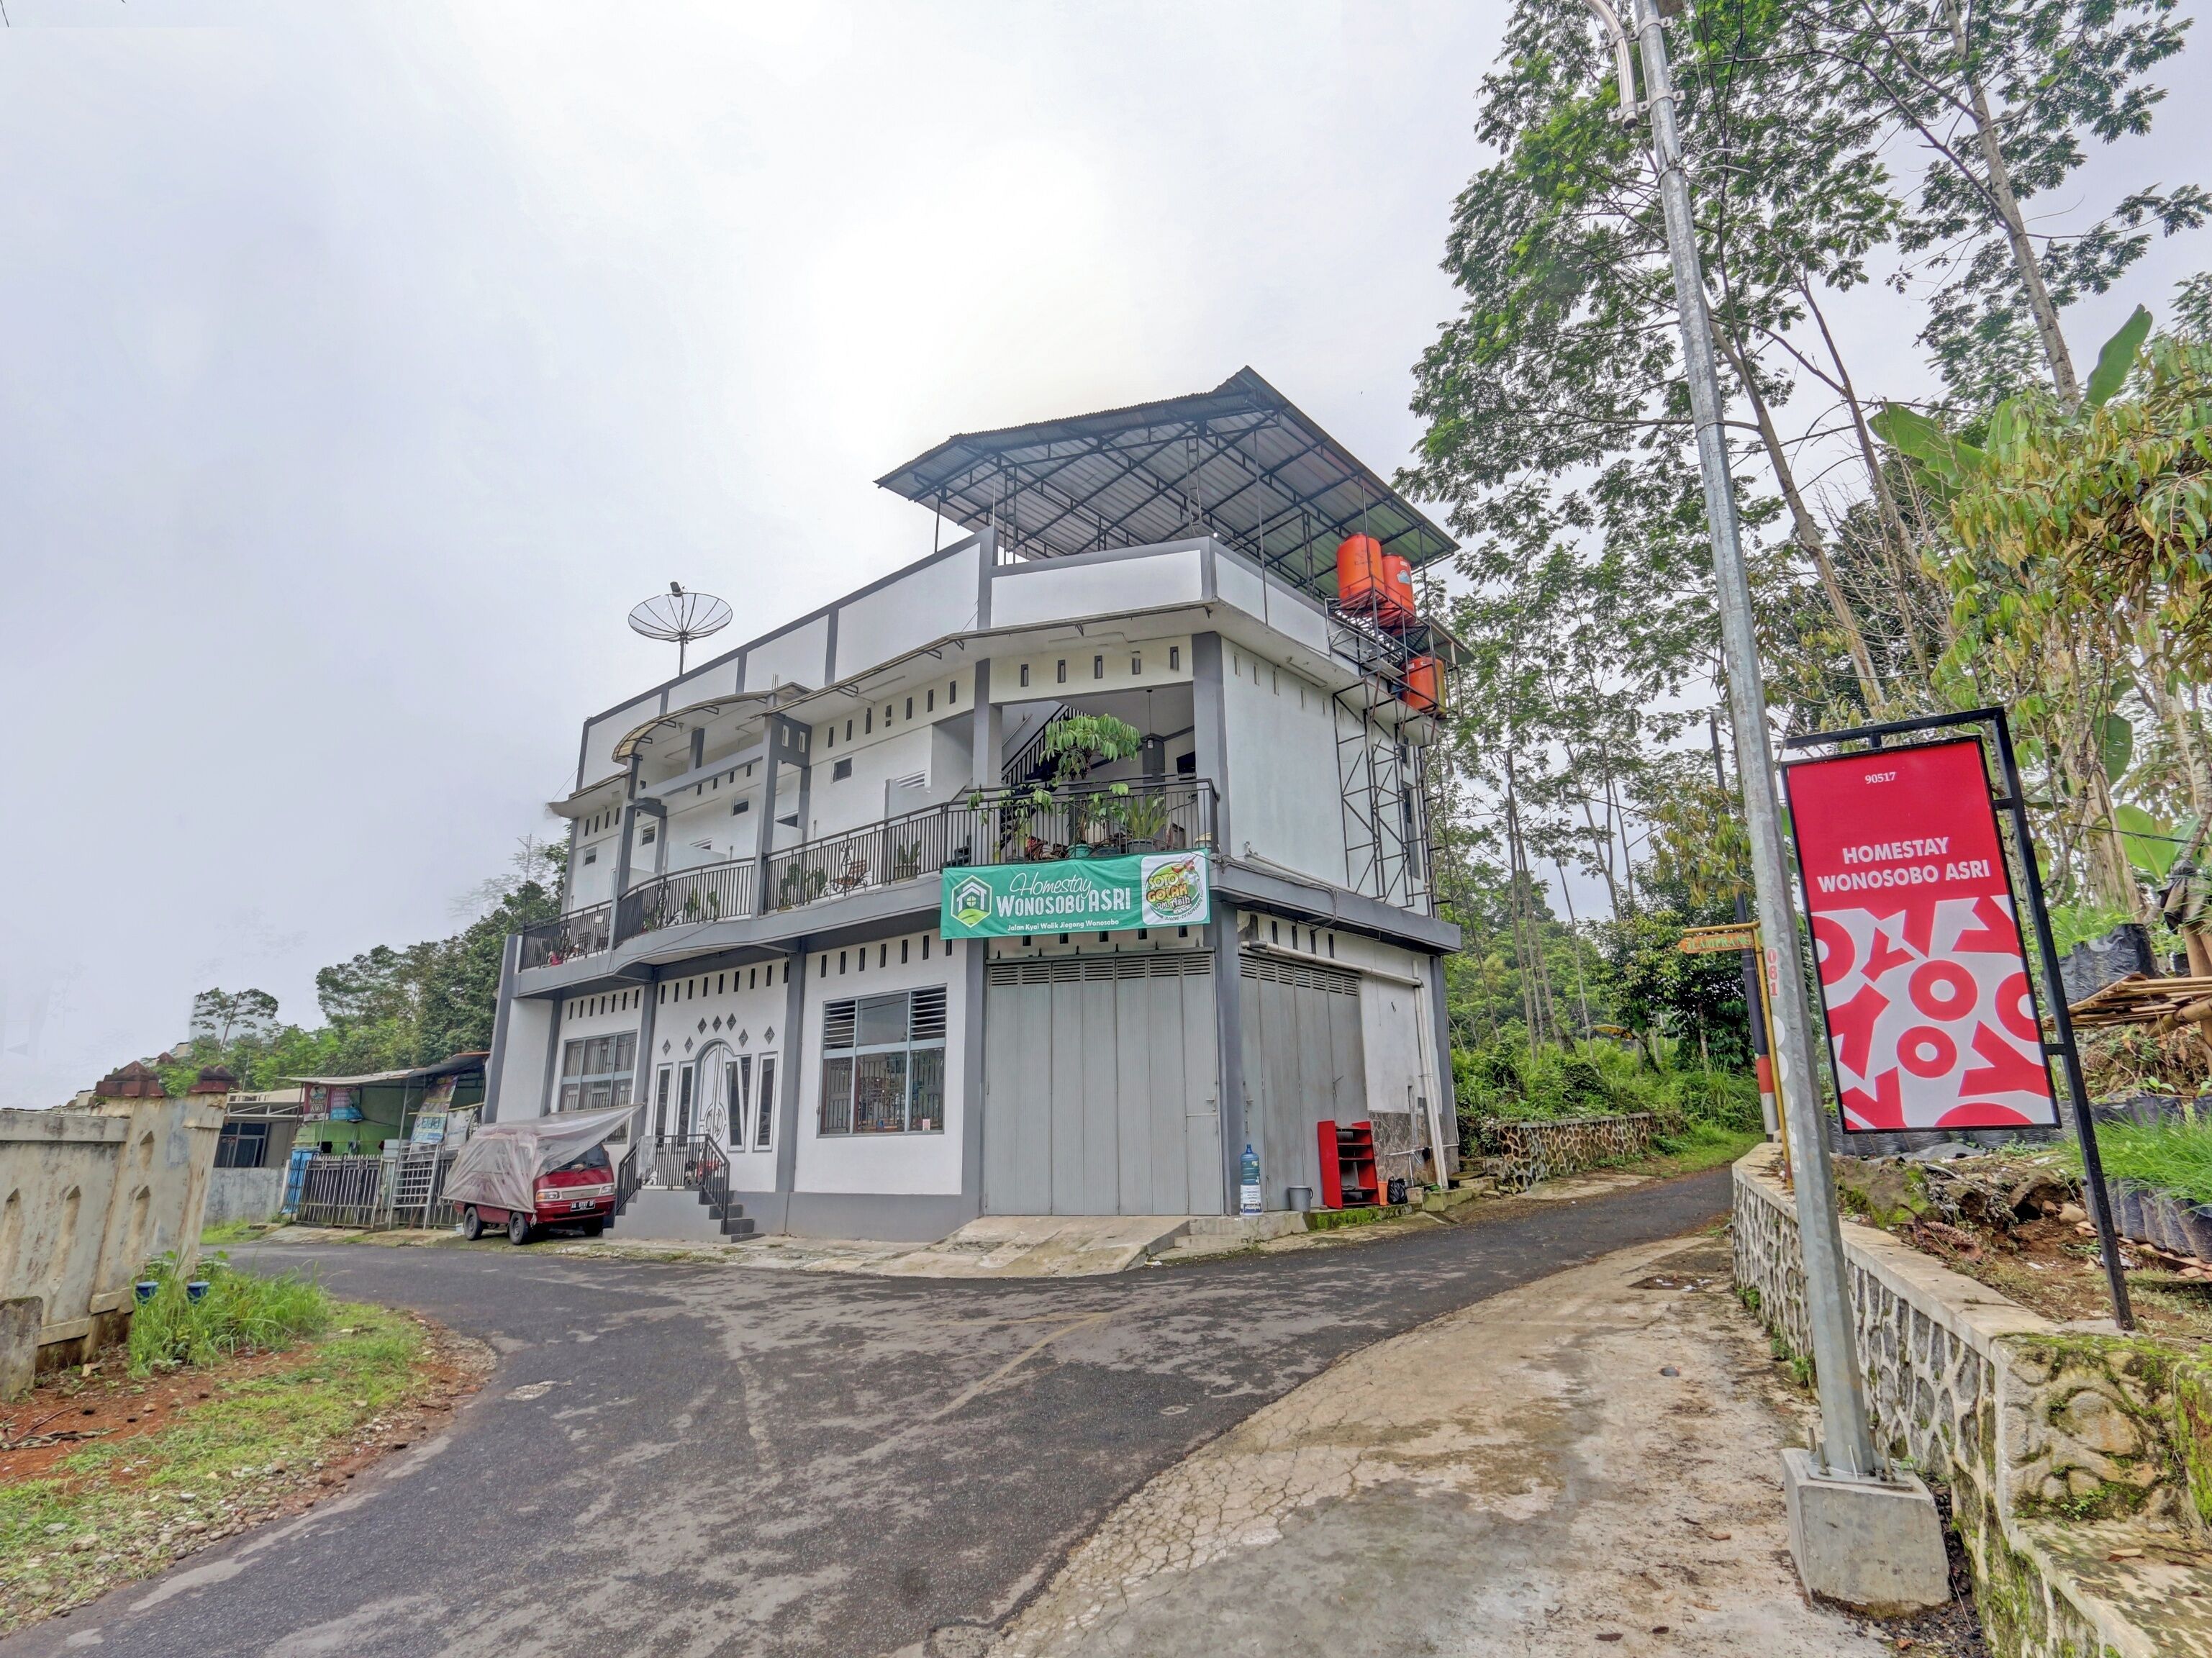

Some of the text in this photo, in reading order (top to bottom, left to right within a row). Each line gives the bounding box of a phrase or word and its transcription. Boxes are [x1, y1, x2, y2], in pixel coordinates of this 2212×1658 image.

[1865, 771, 1897, 784] 90517
[1842, 836, 1949, 864] HOMESTAY
[1010, 871, 1092, 899] Homestay
[1148, 873, 1179, 889] SOTO
[1817, 859, 1991, 893] WONOSOBO ASRI
[996, 887, 1130, 918] WONOSOBO ASRI
[1171, 895, 1190, 908] Asih
[1767, 948, 1778, 996] 061
